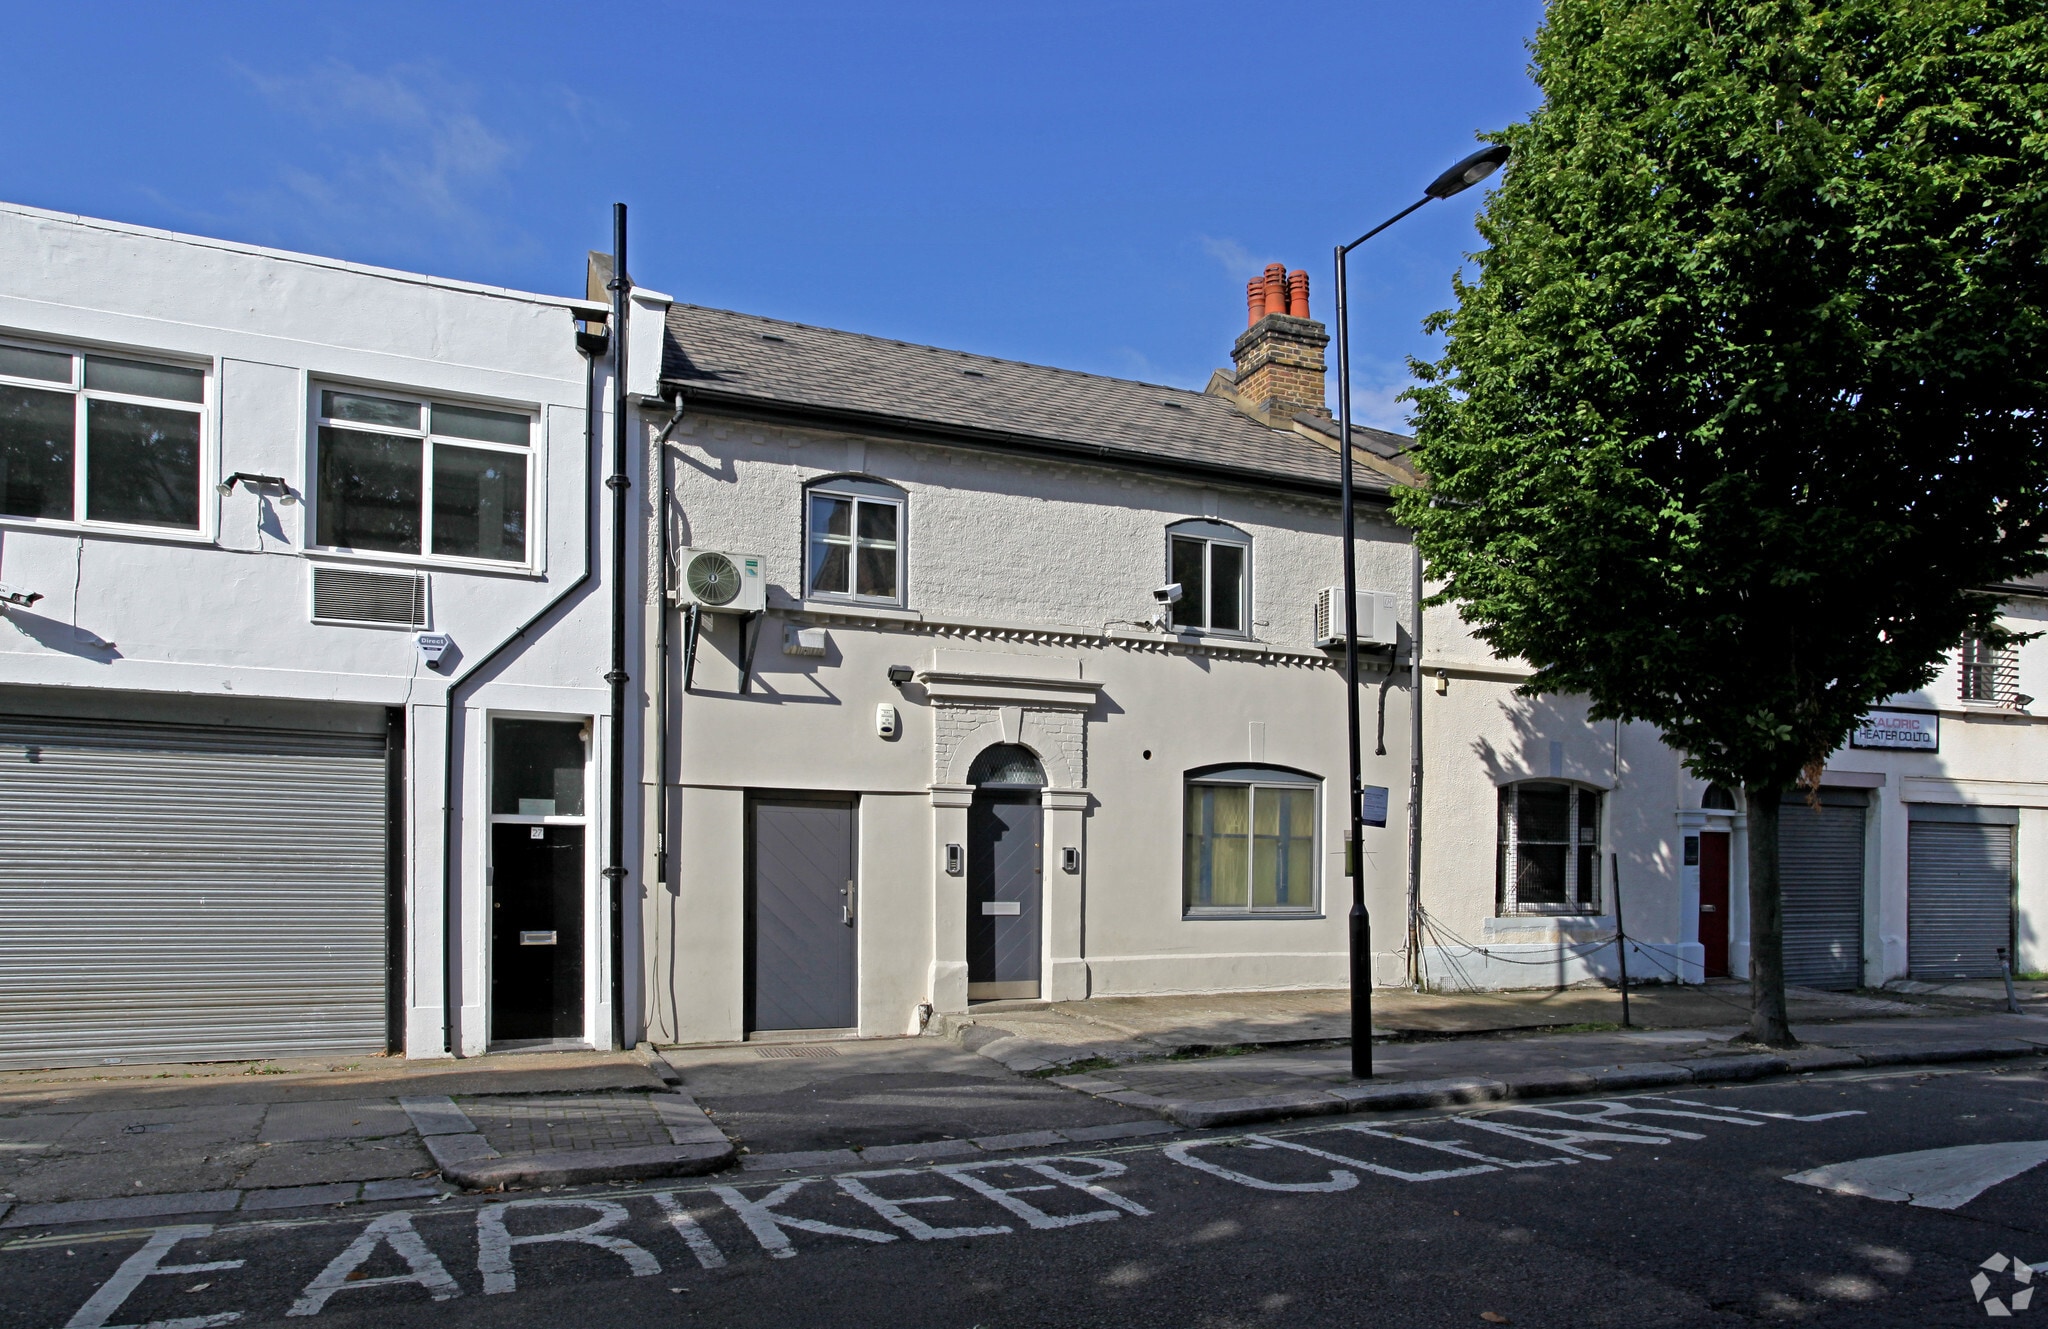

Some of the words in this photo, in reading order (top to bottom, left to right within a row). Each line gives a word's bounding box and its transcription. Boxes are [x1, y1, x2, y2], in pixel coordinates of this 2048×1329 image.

[421, 637, 445, 645] Direct
[1859, 729, 1898, 740] HEATER
[532, 828, 543, 838] 27
[708, 1155, 1154, 1260] KEEP
[1162, 1101, 1768, 1193] CLEAR
